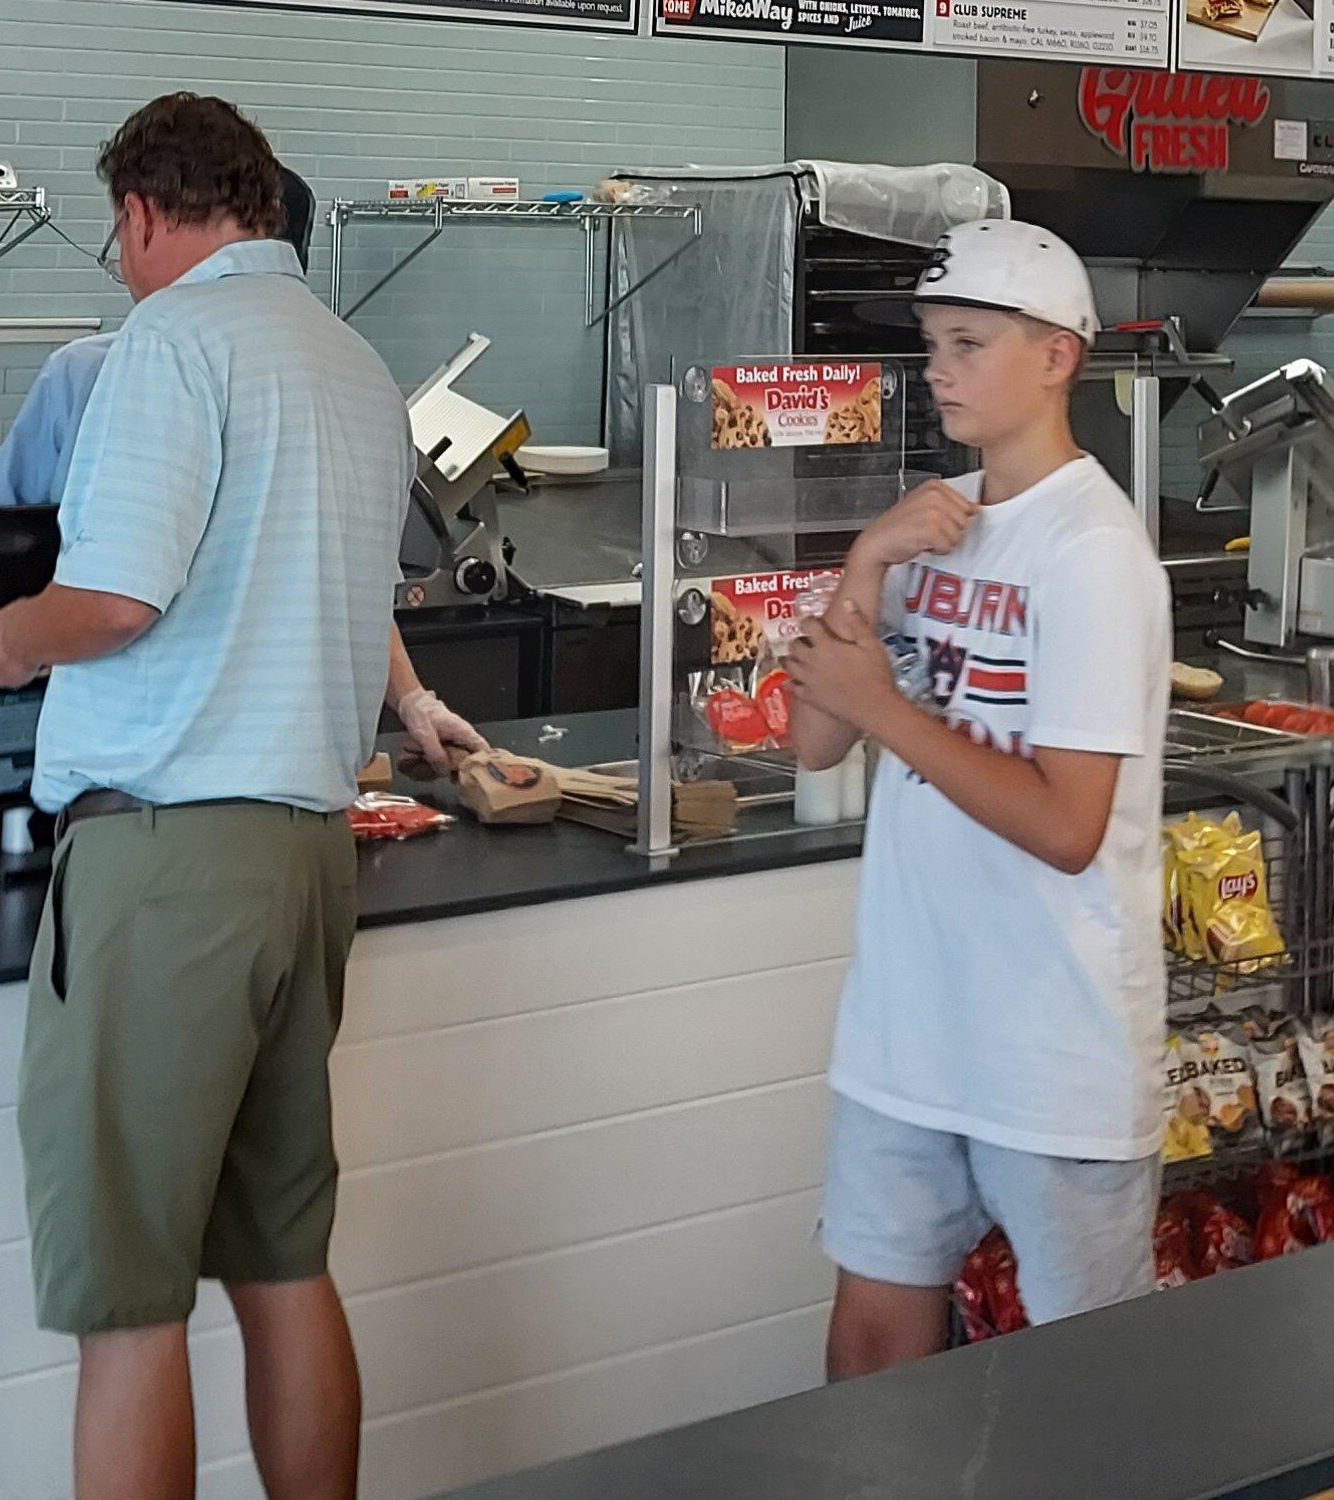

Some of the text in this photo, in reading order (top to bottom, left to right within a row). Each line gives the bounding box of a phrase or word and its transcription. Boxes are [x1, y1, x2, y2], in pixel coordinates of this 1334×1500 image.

[798, 0, 920, 19] WITH ONIONS, LETTUCE, TOMATOES,
[953, 4, 1027, 20] CLUB SUPREME
[798, 12, 872, 32] SPICES AND Juice
[1131, 122, 1228, 172] FRESH
[736, 366, 860, 383] Baked Fresh Daily!
[767, 387, 830, 412] David's
[778, 412, 818, 427] Cookies
[905, 562, 1028, 635] UBURN
[1220, 871, 1258, 898] Lay's
[1185, 1057, 1246, 1077] BAKED
